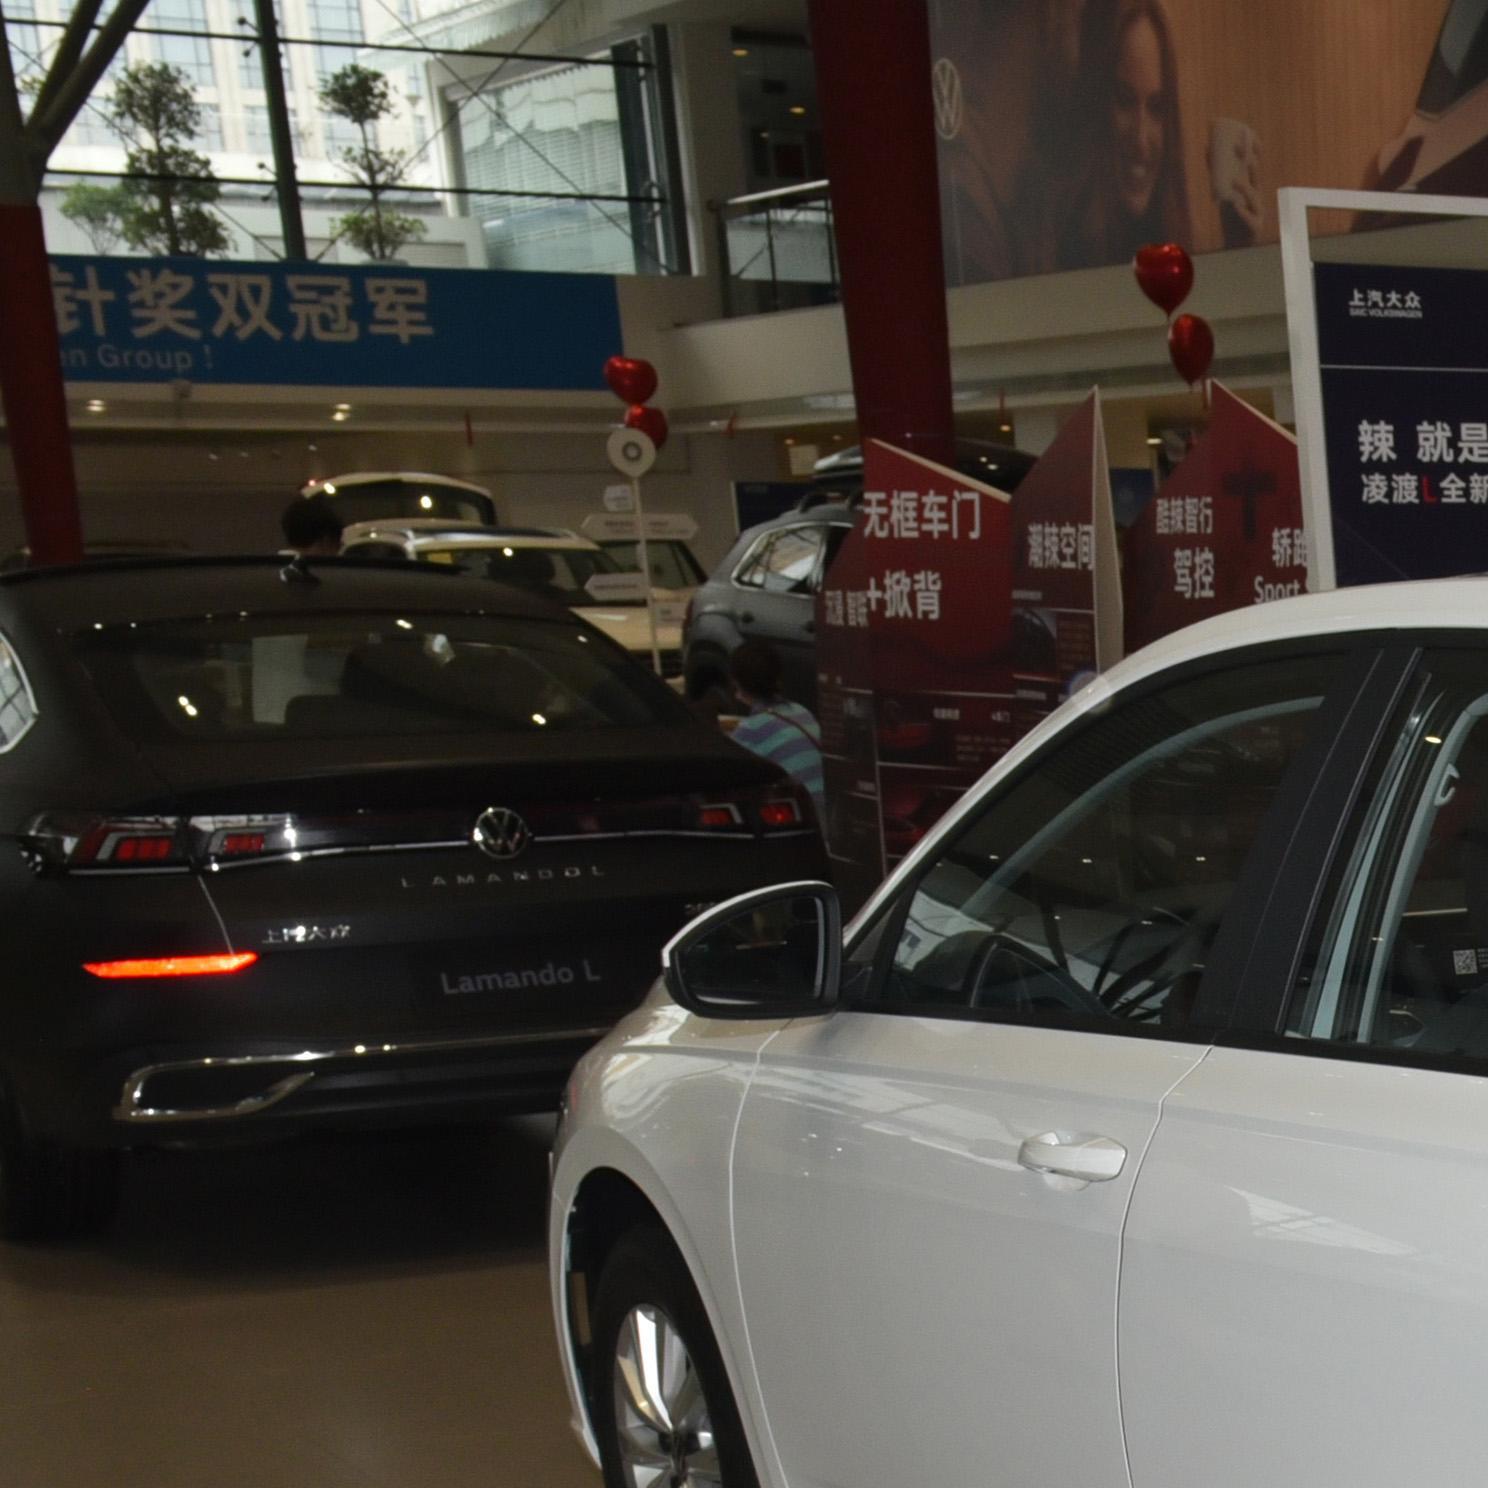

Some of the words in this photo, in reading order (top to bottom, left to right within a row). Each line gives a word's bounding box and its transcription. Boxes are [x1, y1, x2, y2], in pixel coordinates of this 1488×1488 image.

[1348, 288, 1421, 308] 上汽大众
[1358, 420, 1397, 463] 辣
[863, 489, 981, 540] 无框车门
[1173, 546, 1216, 599] 驾控
[440, 962, 575, 995] Lamando
[583, 958, 602, 982] L
